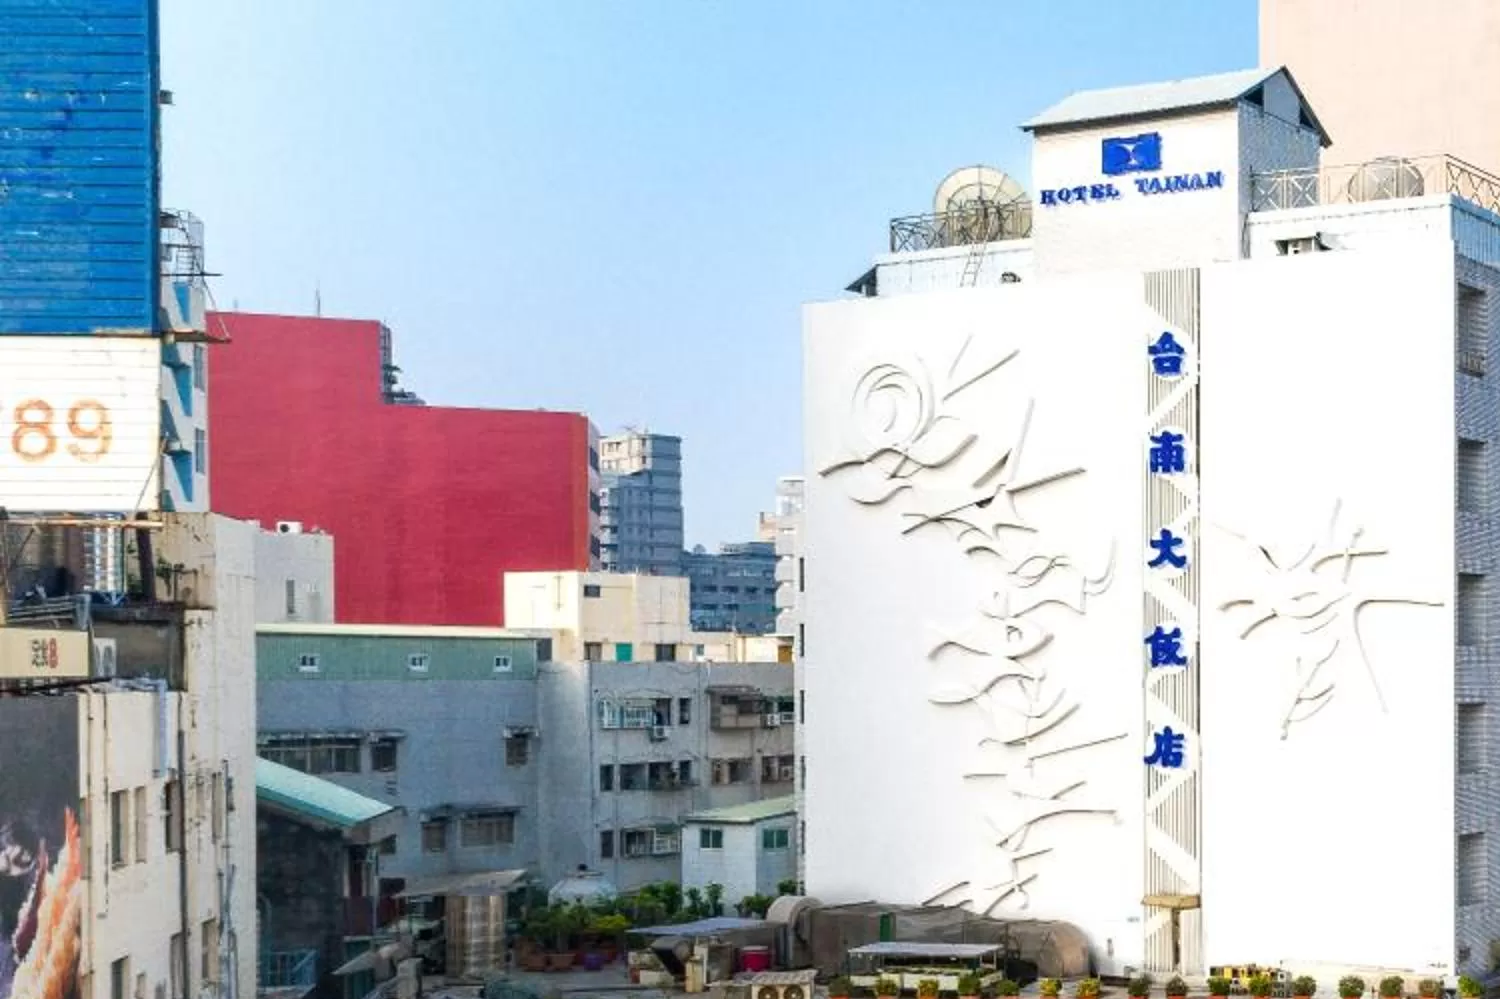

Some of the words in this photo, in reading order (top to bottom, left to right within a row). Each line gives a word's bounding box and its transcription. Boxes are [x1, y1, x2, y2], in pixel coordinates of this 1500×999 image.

[1040, 183, 1120, 206] HOTEL
[1134, 171, 1224, 195] TAINAN
[0, 398, 114, 464] 89
[1144, 331, 1189, 769] 台南大飯店
